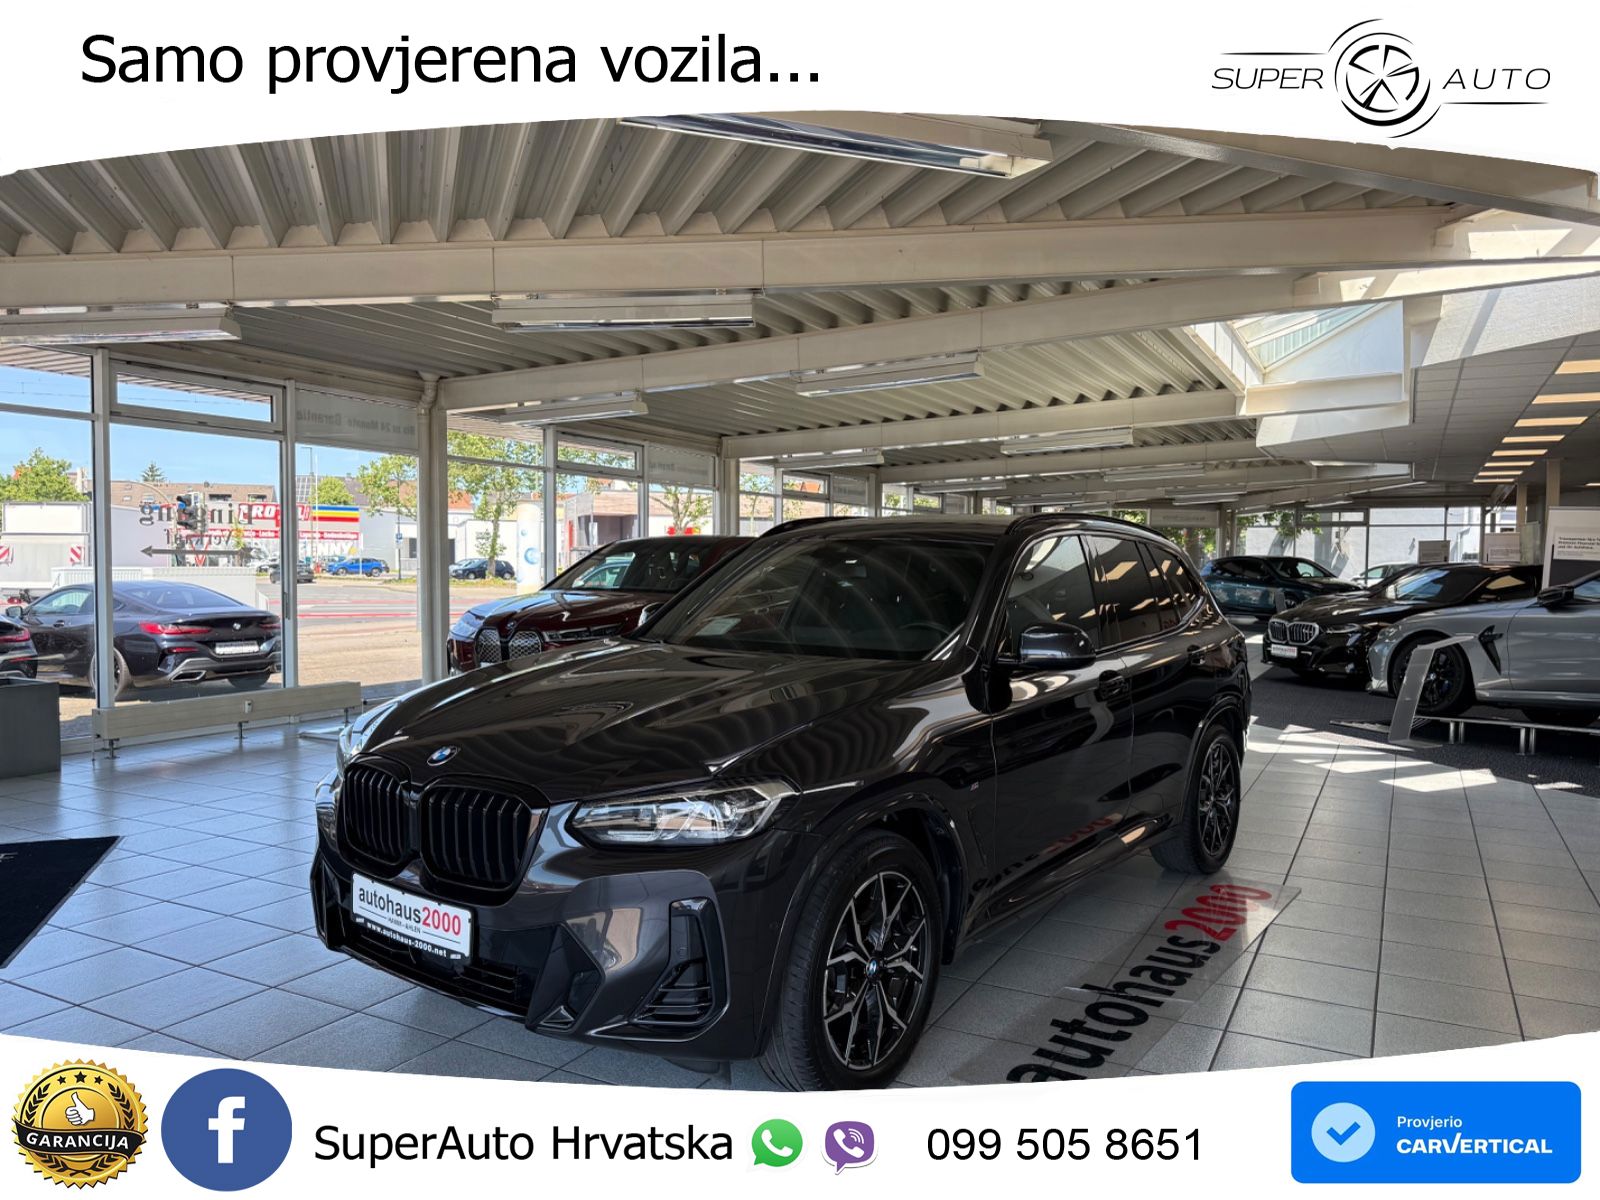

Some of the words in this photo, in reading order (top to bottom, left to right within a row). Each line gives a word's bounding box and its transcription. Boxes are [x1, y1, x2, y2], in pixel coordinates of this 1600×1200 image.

[358, 887, 461, 936] autohaus2000
[366, 922, 447, 958] www.autohaus-2000.net
[1006, 884, 1273, 1083] autohaus2000
